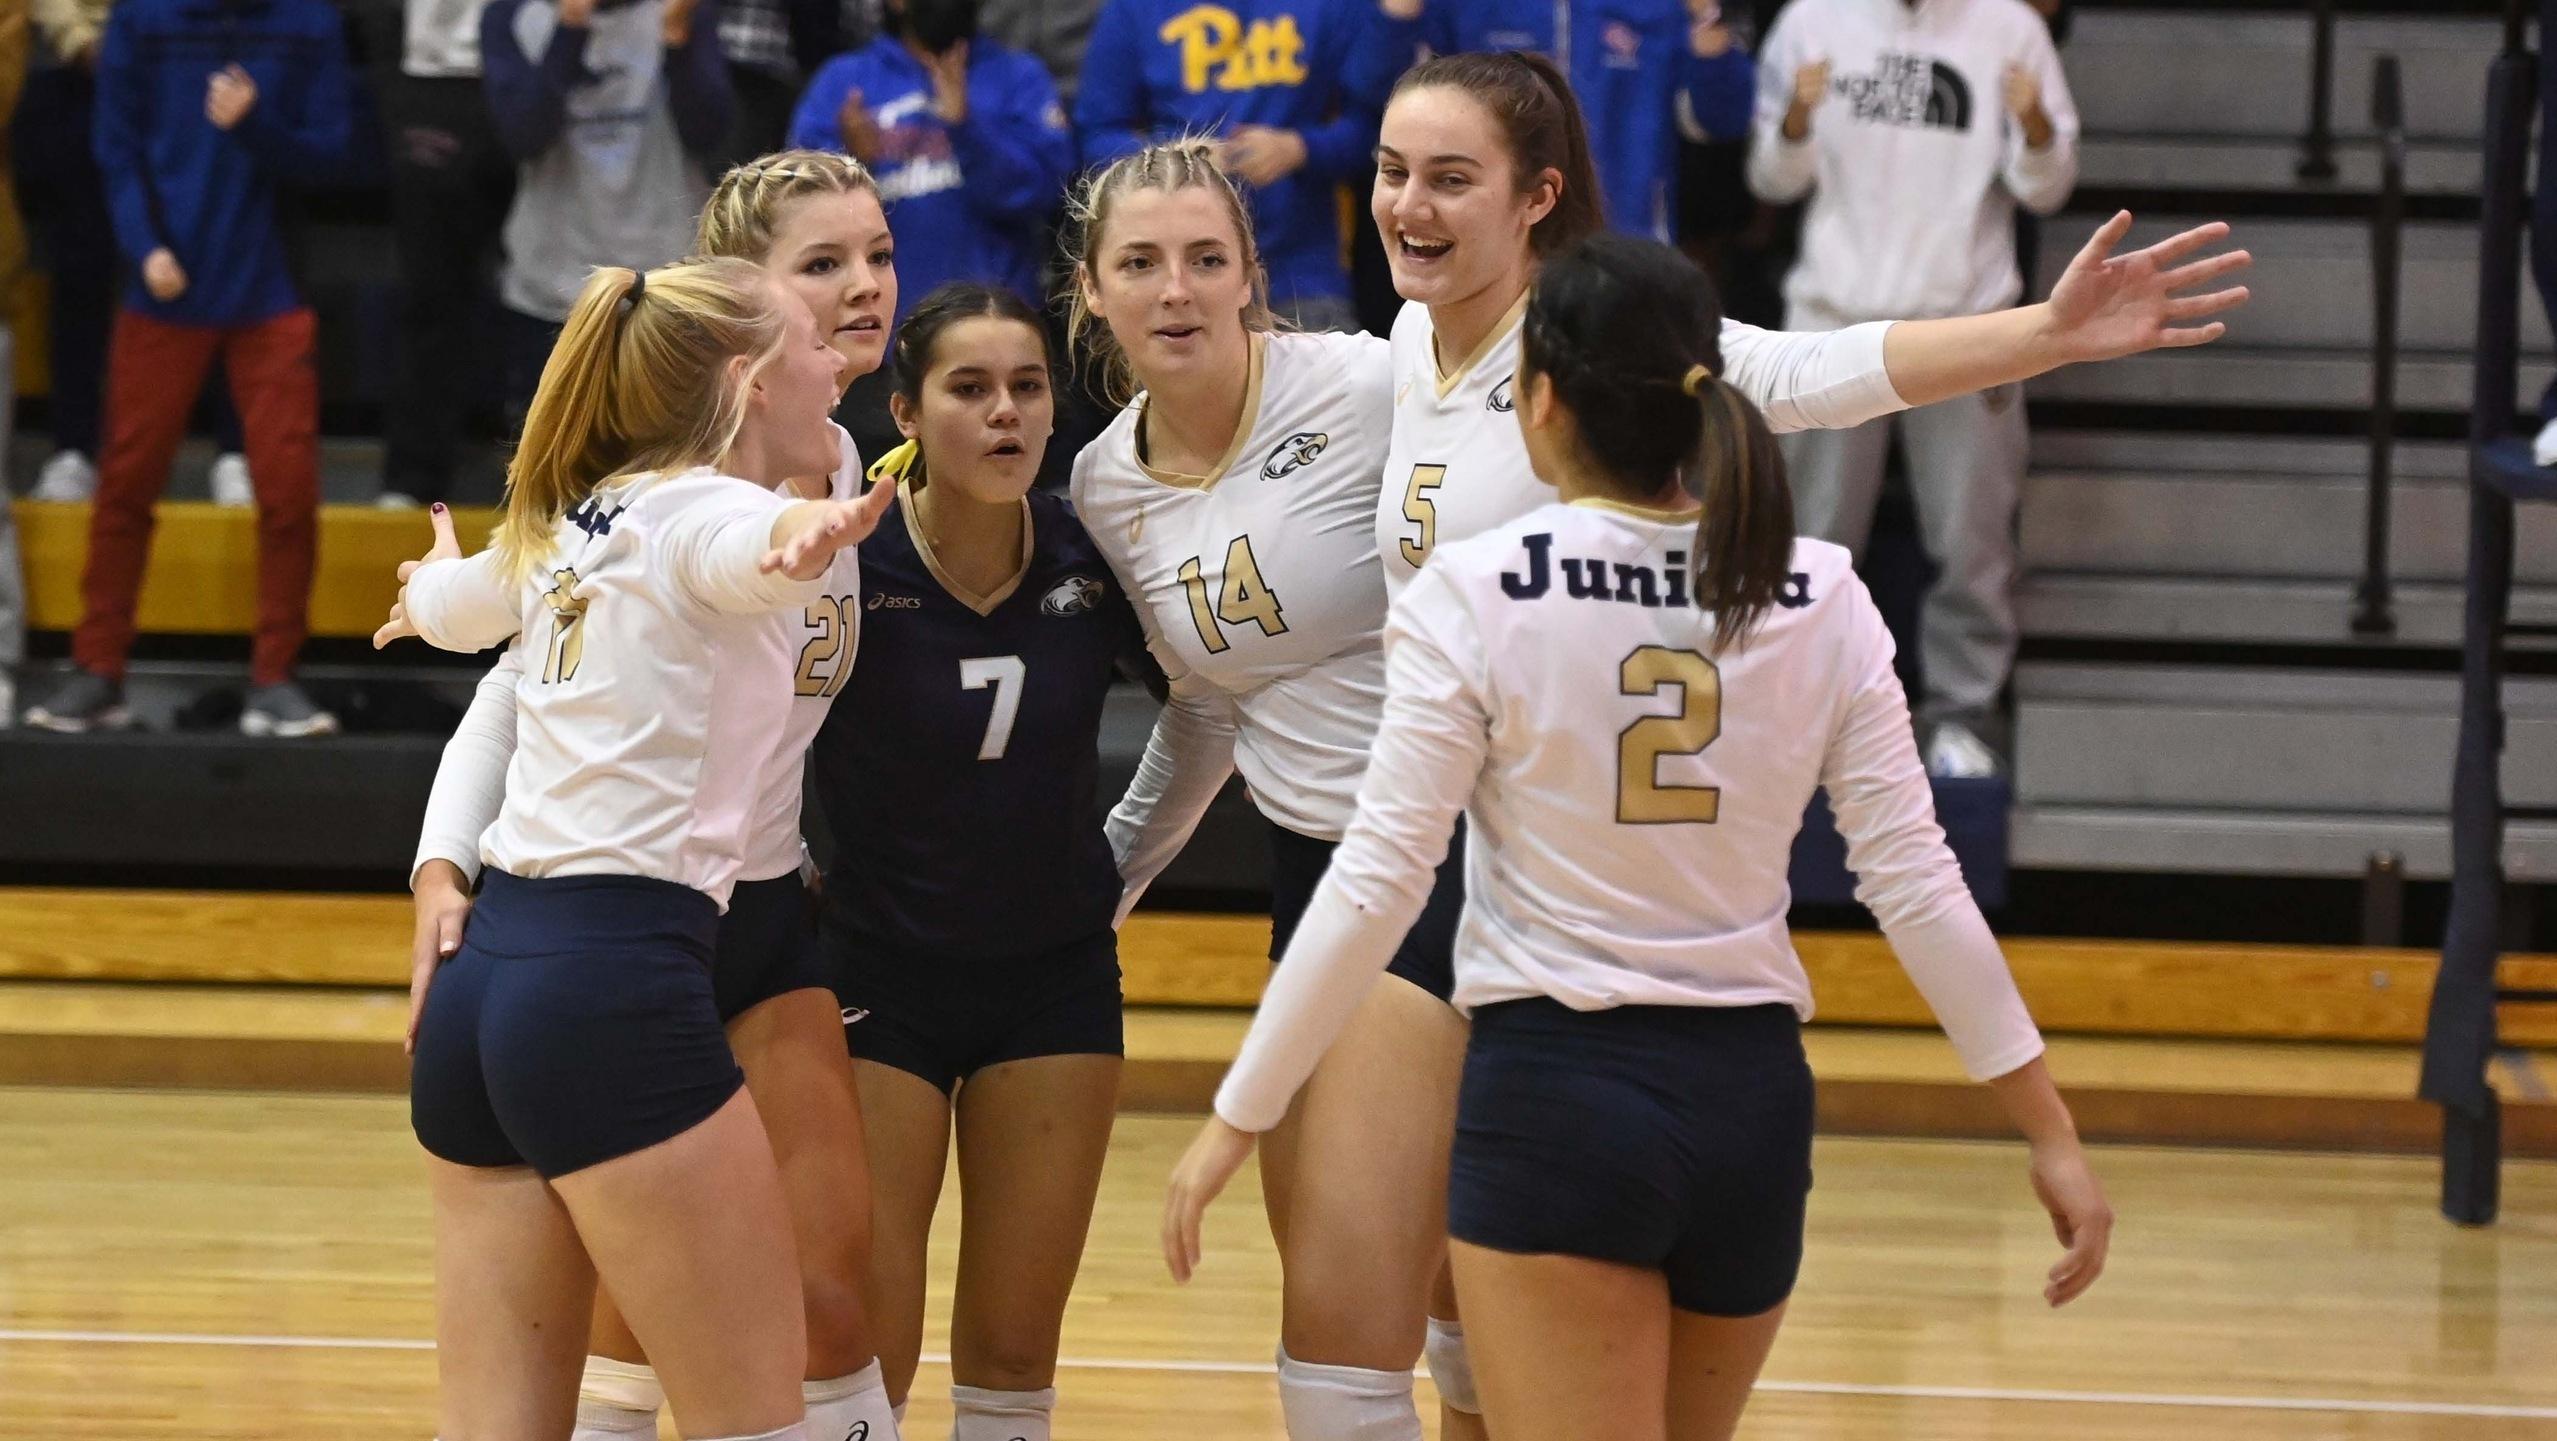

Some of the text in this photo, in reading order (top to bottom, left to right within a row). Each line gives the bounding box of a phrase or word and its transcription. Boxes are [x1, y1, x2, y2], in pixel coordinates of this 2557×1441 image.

[1159, 4, 1308, 93] Pitt
[1400, 463, 1447, 569] 5
[885, 596, 921, 609] asics
[1177, 534, 1289, 654] 14
[1501, 533, 1816, 609] Junia
[794, 594, 856, 697] 21
[959, 655, 1026, 761] 7
[1616, 645, 1722, 824] 2
